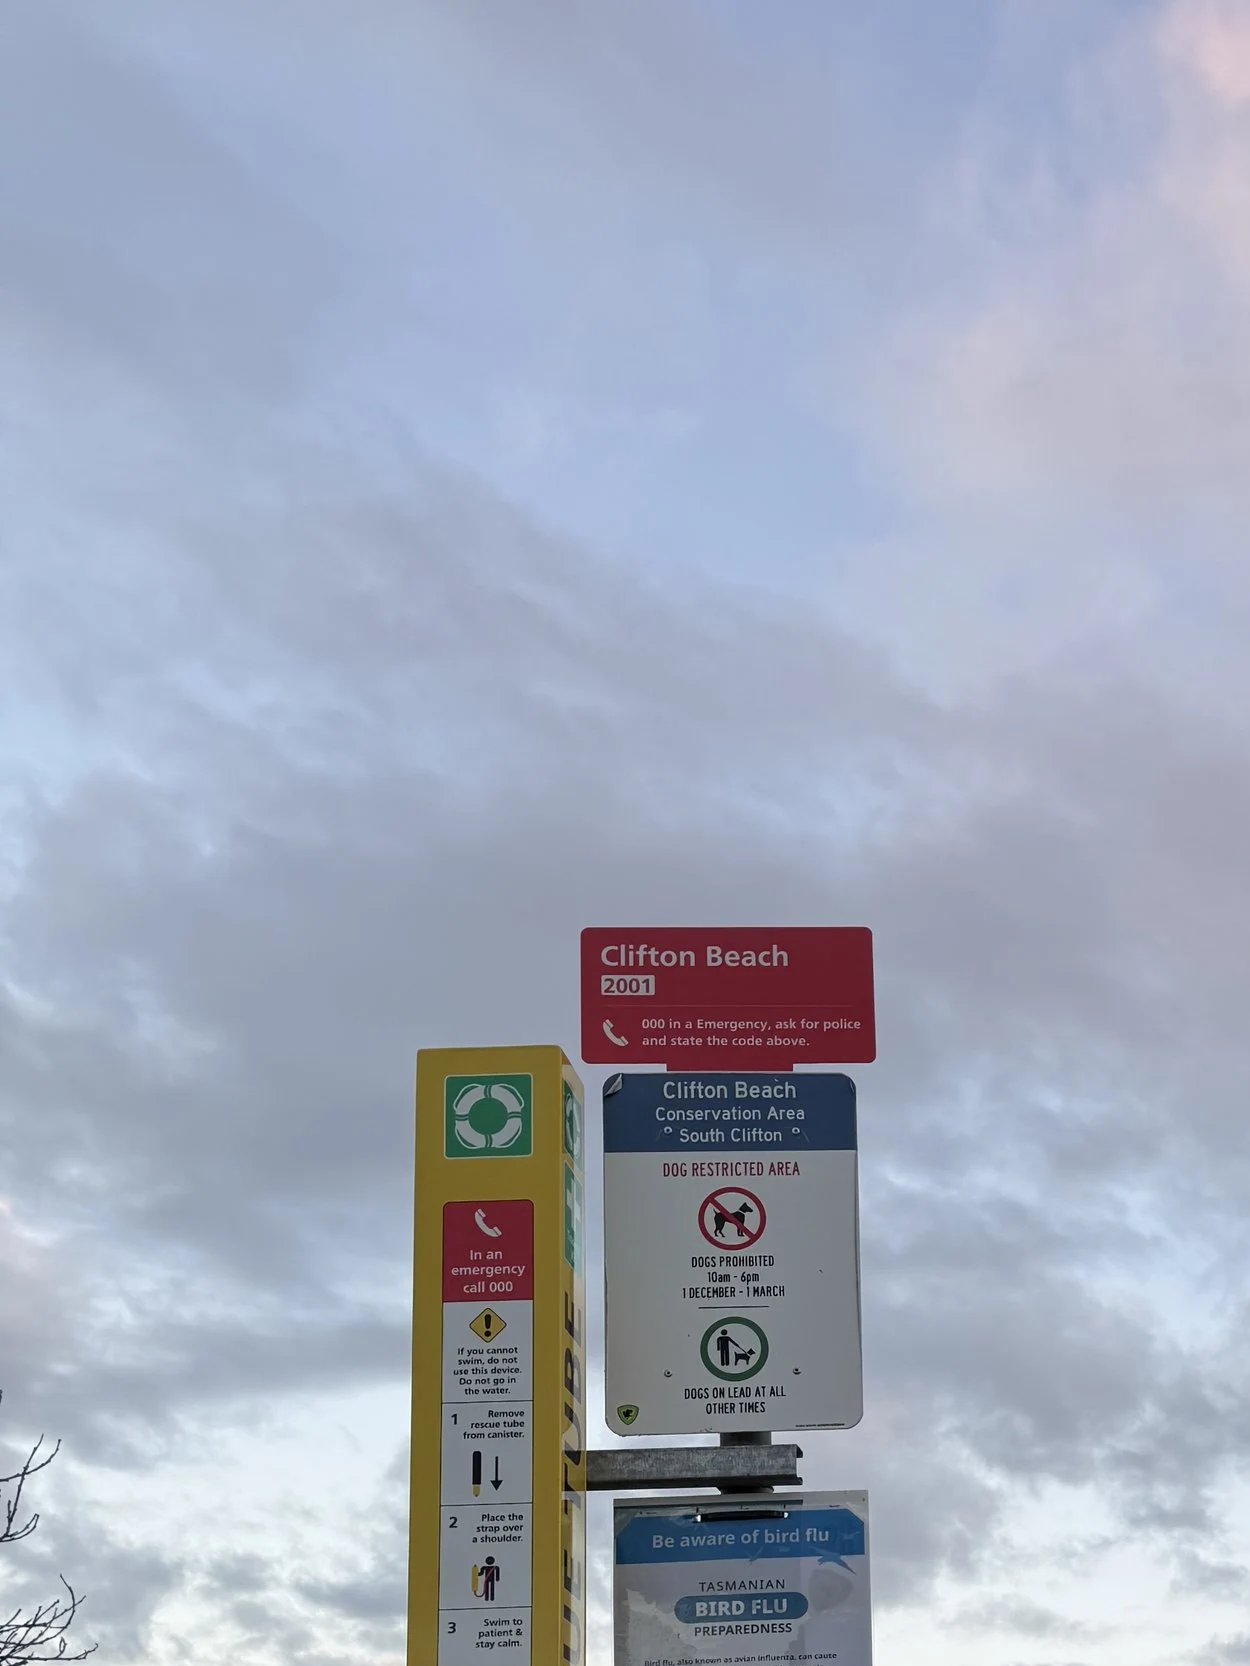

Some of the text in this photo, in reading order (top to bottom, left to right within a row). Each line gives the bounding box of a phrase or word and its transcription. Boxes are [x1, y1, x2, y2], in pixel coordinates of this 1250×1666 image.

[601, 944, 789, 967] Clifton Beach
[603, 978, 652, 994] 2001
[641, 1018, 861, 1032] 000 in a Emergency, ask for police
[642, 1036, 810, 1046] and state the code above.
[663, 1081, 797, 1099] Clifton Beach
[655, 1107, 805, 1121] Conservation Area
[679, 1127, 782, 1143] South Clifton
[663, 1161, 800, 1177] DOG RESTRICTED AREA
[470, 1250, 503, 1260] In an
[691, 1255, 775, 1268] DOGS PROHIBITED
[451, 1265, 526, 1277] emergency
[707, 1271, 731, 1283] 10am
[740, 1271, 760, 1285] 6pm
[463, 1281, 513, 1293] call 000
[682, 1287, 687, 1299] 1
[689, 1286, 736, 1299] DECEMBER
[746, 1286, 750, 1297] 1
[752, 1285, 785, 1297] MARCH
[457, 1347, 518, 1357] If you cannot
[458, 1357, 485, 1366] swim,
[472, 1367, 488, 1375] this
[491, 1366, 522, 1374] device.
[493, 1378, 505, 1386] go
[684, 1385, 786, 1400] DOGS ON LEAD AT ALL
[563, 1290, 582, 1516] TUBE
[706, 1402, 766, 1415] OTHER TIMES
[451, 1413, 458, 1425] 1
[488, 1410, 524, 1418] Remove
[463, 1431, 524, 1439] from canister.
[449, 1517, 458, 1528] 2
[482, 1514, 505, 1522] Place
[476, 1525, 500, 1533] strap
[480, 1534, 523, 1543] shoulder.
[652, 1528, 829, 1548] Be aware of bird flu
[699, 1579, 786, 1592] TASMANIAN
[695, 1598, 788, 1617] BIRD FLU
[448, 1622, 456, 1634] 3
[484, 1618, 510, 1627] Swim
[478, 1628, 523, 1639] patient &
[694, 1623, 793, 1637] PREPAREDNESS
[476, 1639, 523, 1650] stay calm.
